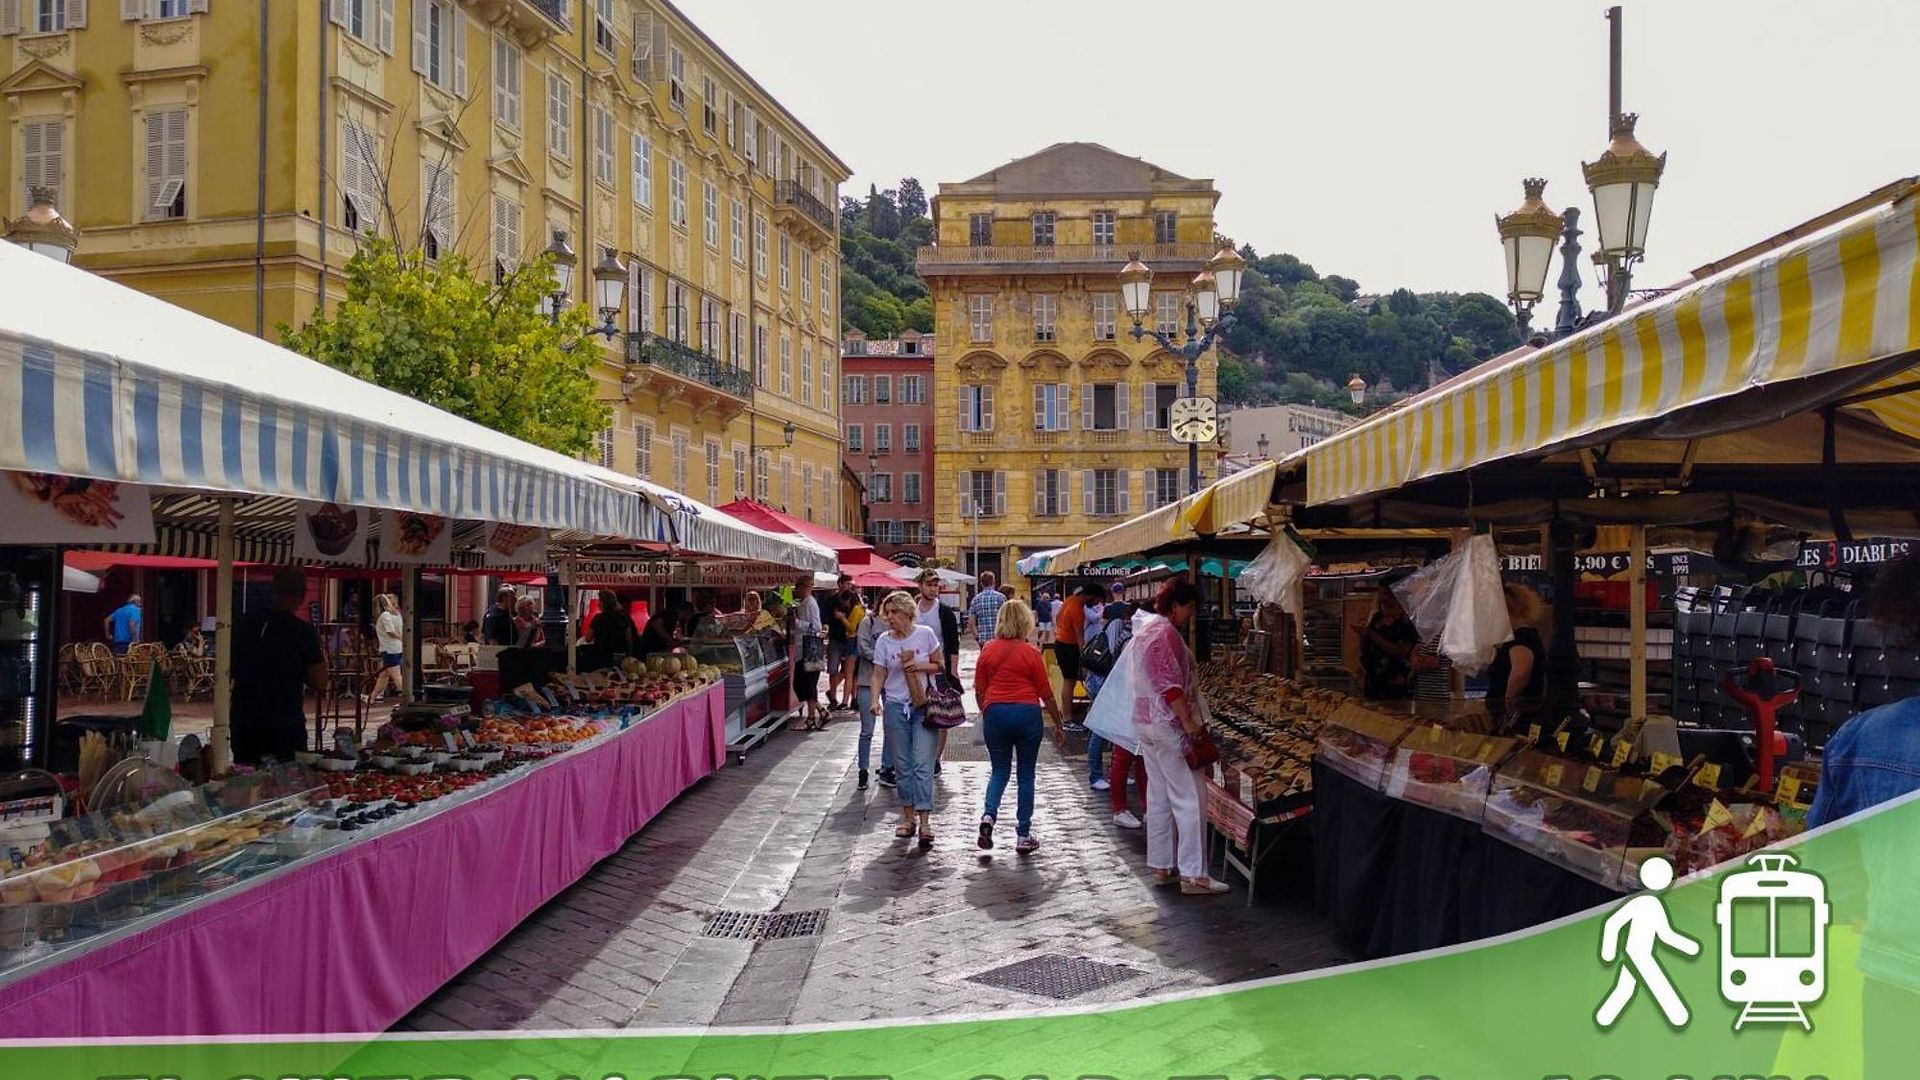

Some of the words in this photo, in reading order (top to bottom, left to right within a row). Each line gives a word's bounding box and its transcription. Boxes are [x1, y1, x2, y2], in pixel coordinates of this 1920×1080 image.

[1825, 542, 1838, 568] 3
[571, 562, 606, 573] OCCA
[610, 562, 627, 573] DU
[1611, 555, 1621, 569] €
[1083, 567, 1131, 576] CONTAINER
